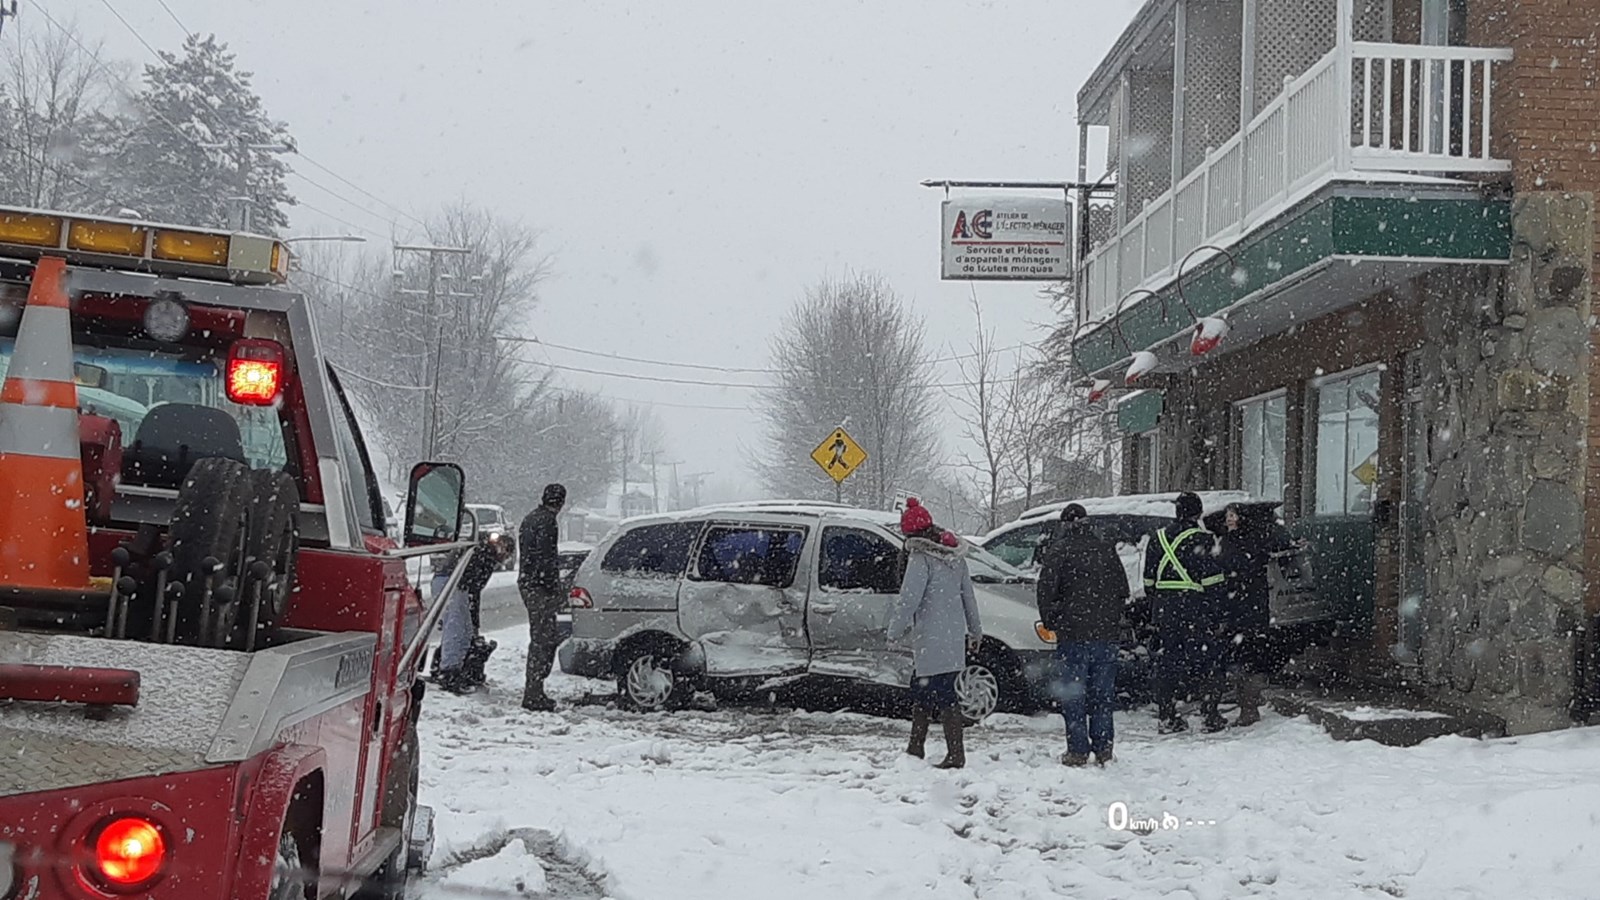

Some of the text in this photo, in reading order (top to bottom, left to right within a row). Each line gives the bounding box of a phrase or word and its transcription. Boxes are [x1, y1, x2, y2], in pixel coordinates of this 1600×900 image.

[966, 246, 1002, 255] Service
[1012, 255, 1060, 265] ménagers
[962, 265, 1053, 274] de toutes marques
